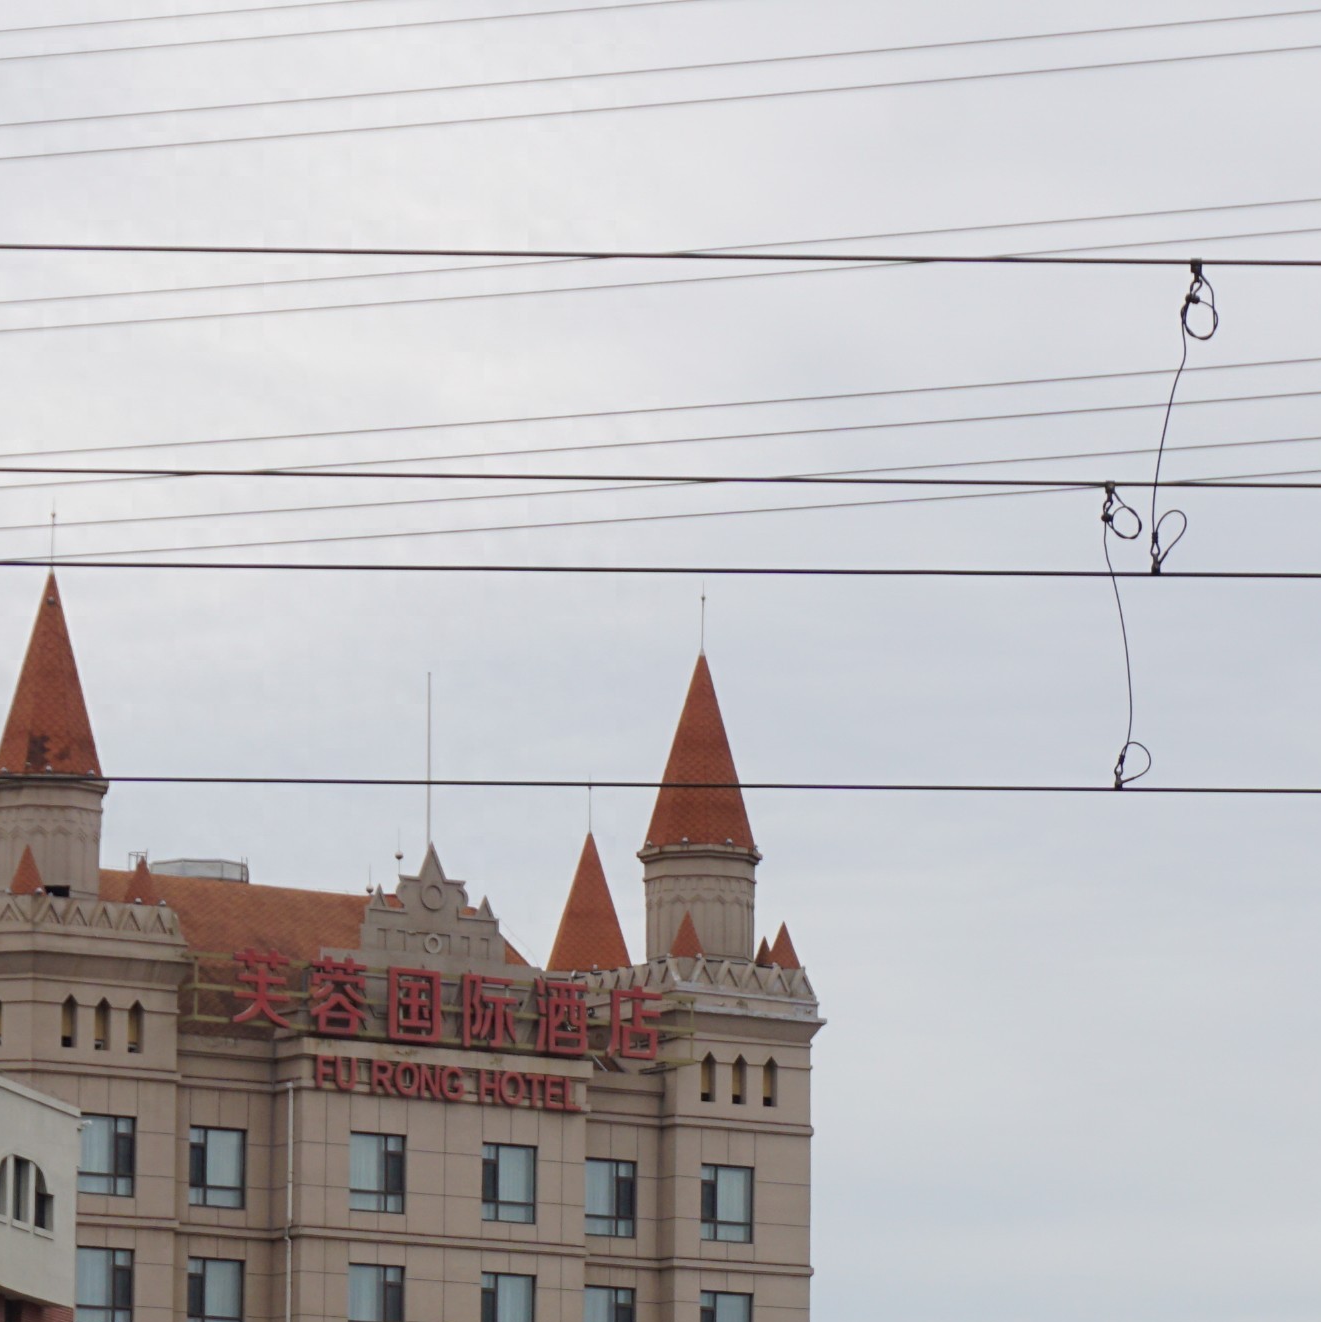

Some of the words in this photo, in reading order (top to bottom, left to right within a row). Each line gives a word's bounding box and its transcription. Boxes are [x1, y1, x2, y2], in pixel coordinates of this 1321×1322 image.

[233, 946, 663, 1060] 芙蓉国际酒店
[315, 1055, 358, 1091] FU
[371, 1059, 465, 1101] RONG
[479, 1069, 581, 1112] HOTEL
